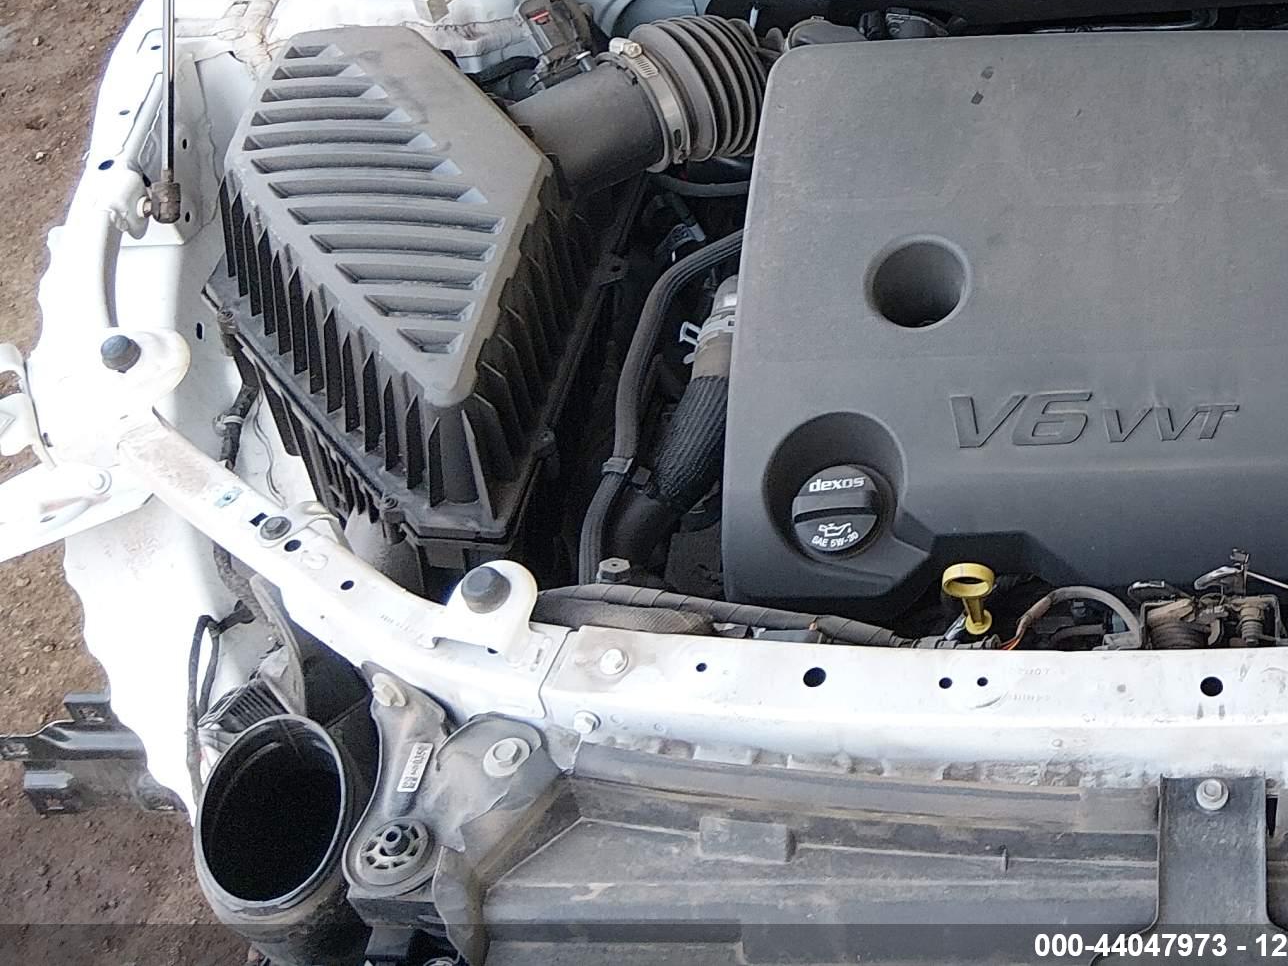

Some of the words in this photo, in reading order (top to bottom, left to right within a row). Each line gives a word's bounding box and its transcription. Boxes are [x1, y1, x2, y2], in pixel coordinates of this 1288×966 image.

[949, 390, 1092, 448] V6
[1102, 403, 1240, 443] VVT
[808, 476, 866, 492] dexos
[811, 534, 829, 547] SAE
